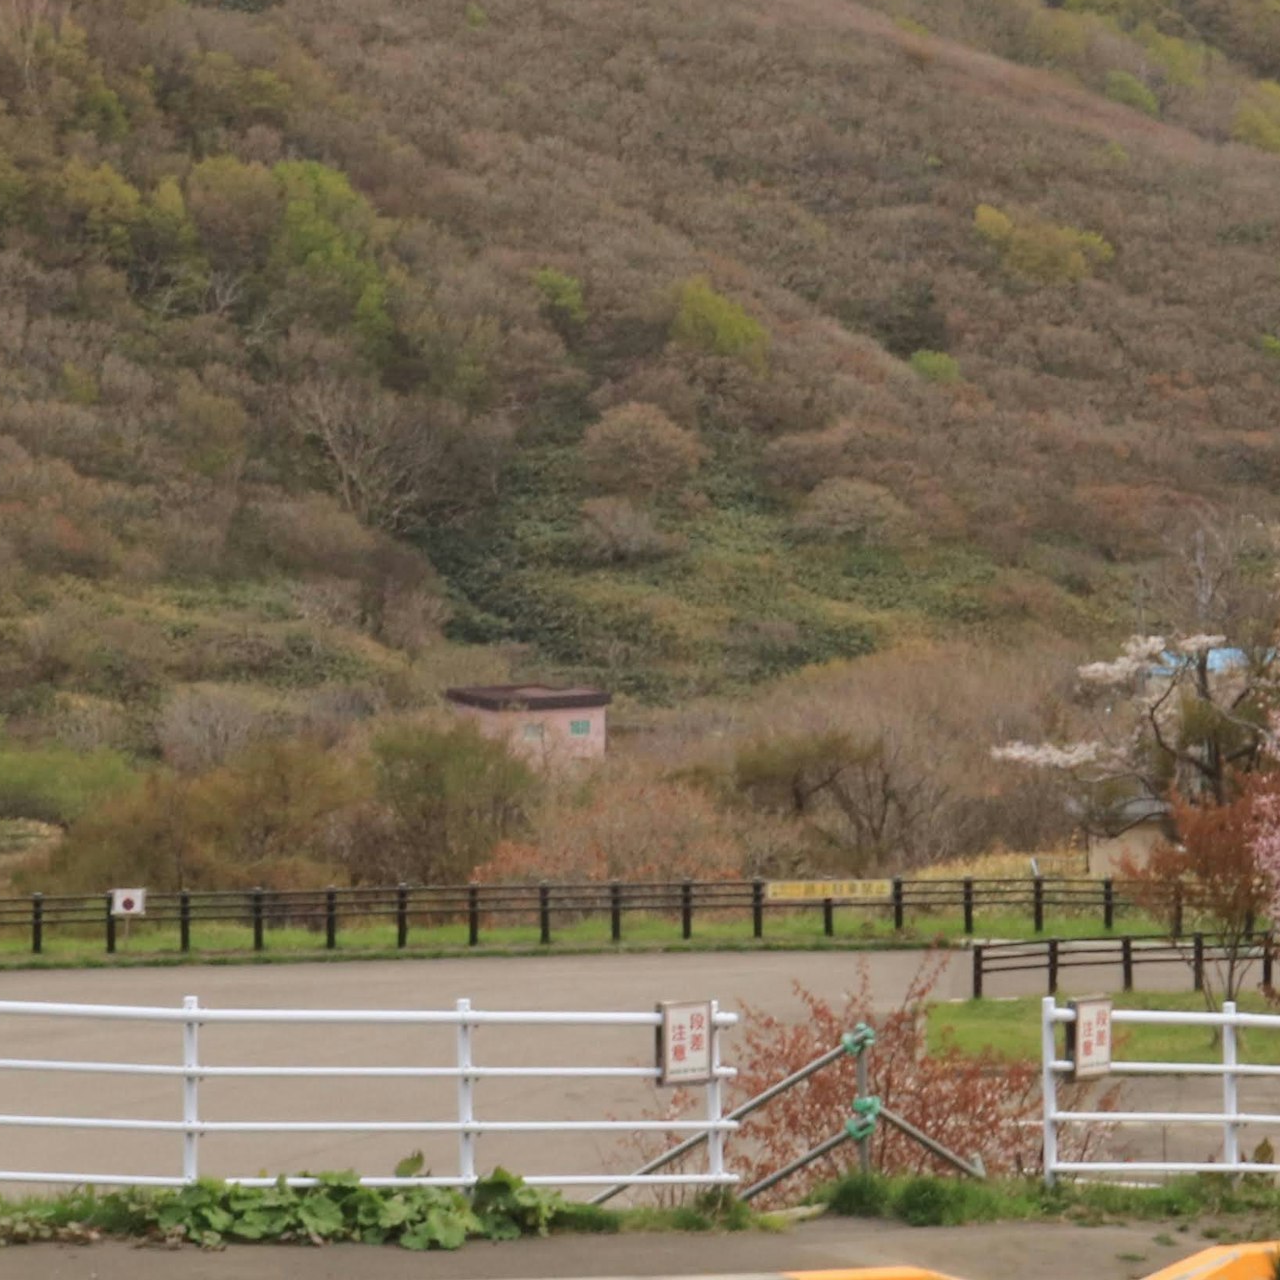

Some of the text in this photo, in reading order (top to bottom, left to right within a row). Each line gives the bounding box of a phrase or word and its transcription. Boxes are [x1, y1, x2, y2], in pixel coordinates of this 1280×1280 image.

[672, 1024, 686, 1061] 注意
[689, 1014, 704, 1051] 段差
[1096, 1009, 1108, 1047] 段差
